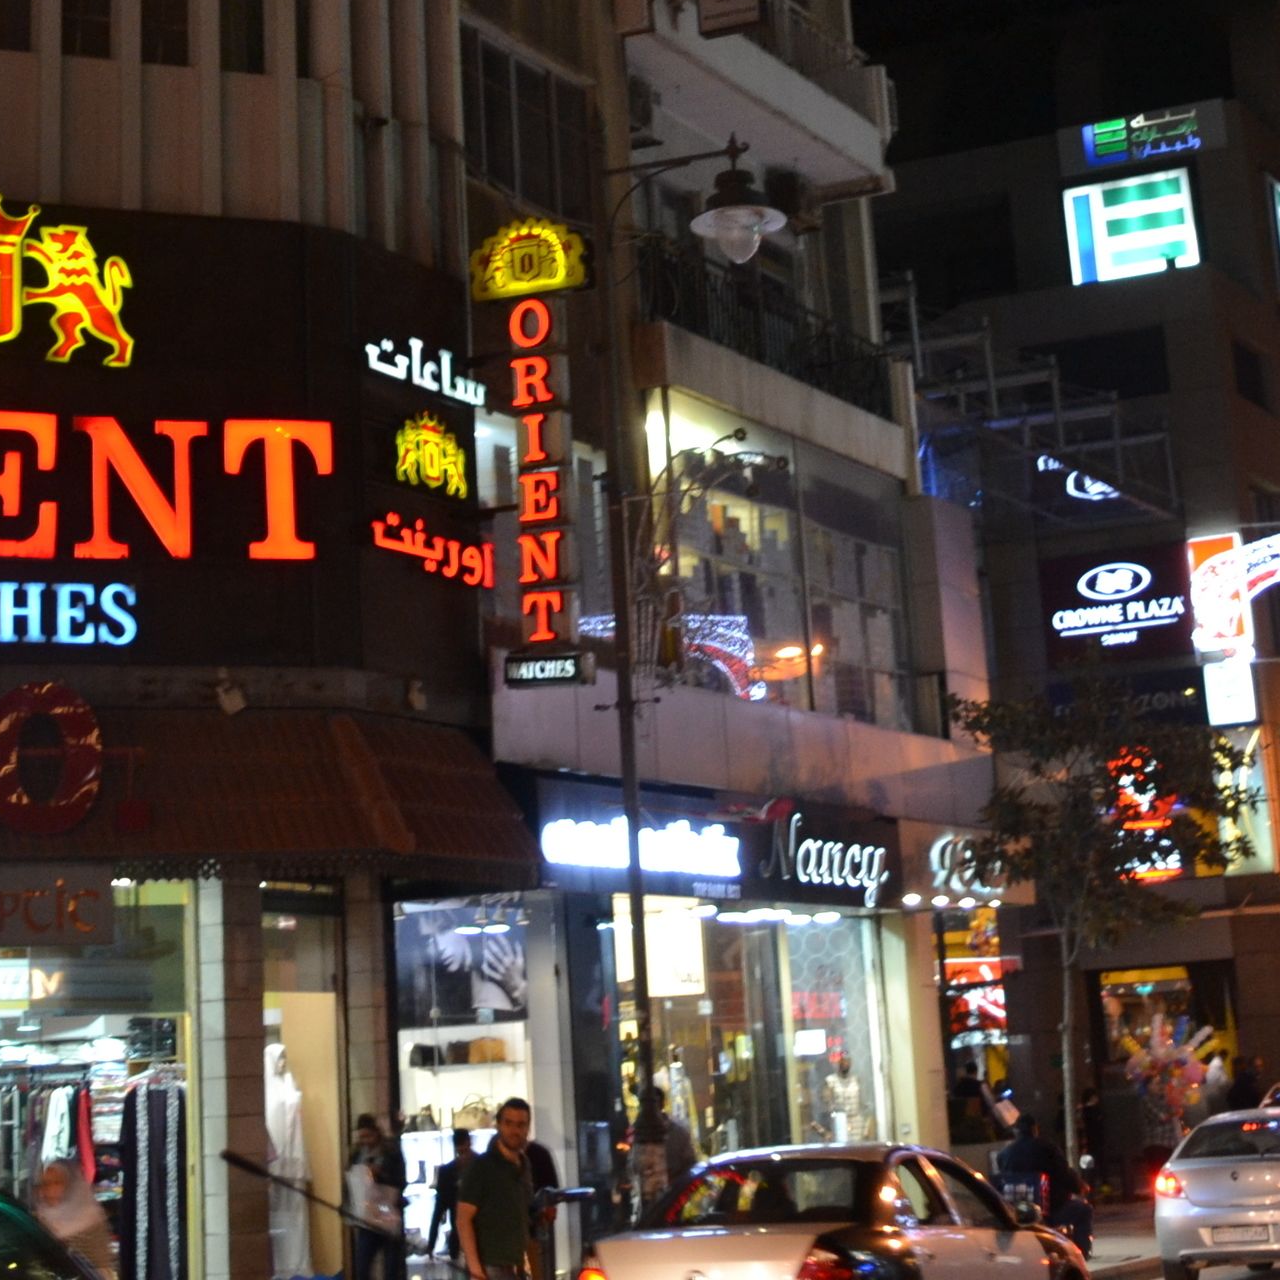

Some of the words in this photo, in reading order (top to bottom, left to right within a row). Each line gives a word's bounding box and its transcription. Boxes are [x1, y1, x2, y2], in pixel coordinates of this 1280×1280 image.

[365, 337, 487, 408] ساعات
[508, 298, 562, 643] ORIENT
[1052, 603, 1124, 630] CROWNE
[1126, 597, 1185, 620] PLAZA
[506, 659, 576, 679] WATCHES
[759, 811, 890, 909] Nancy
